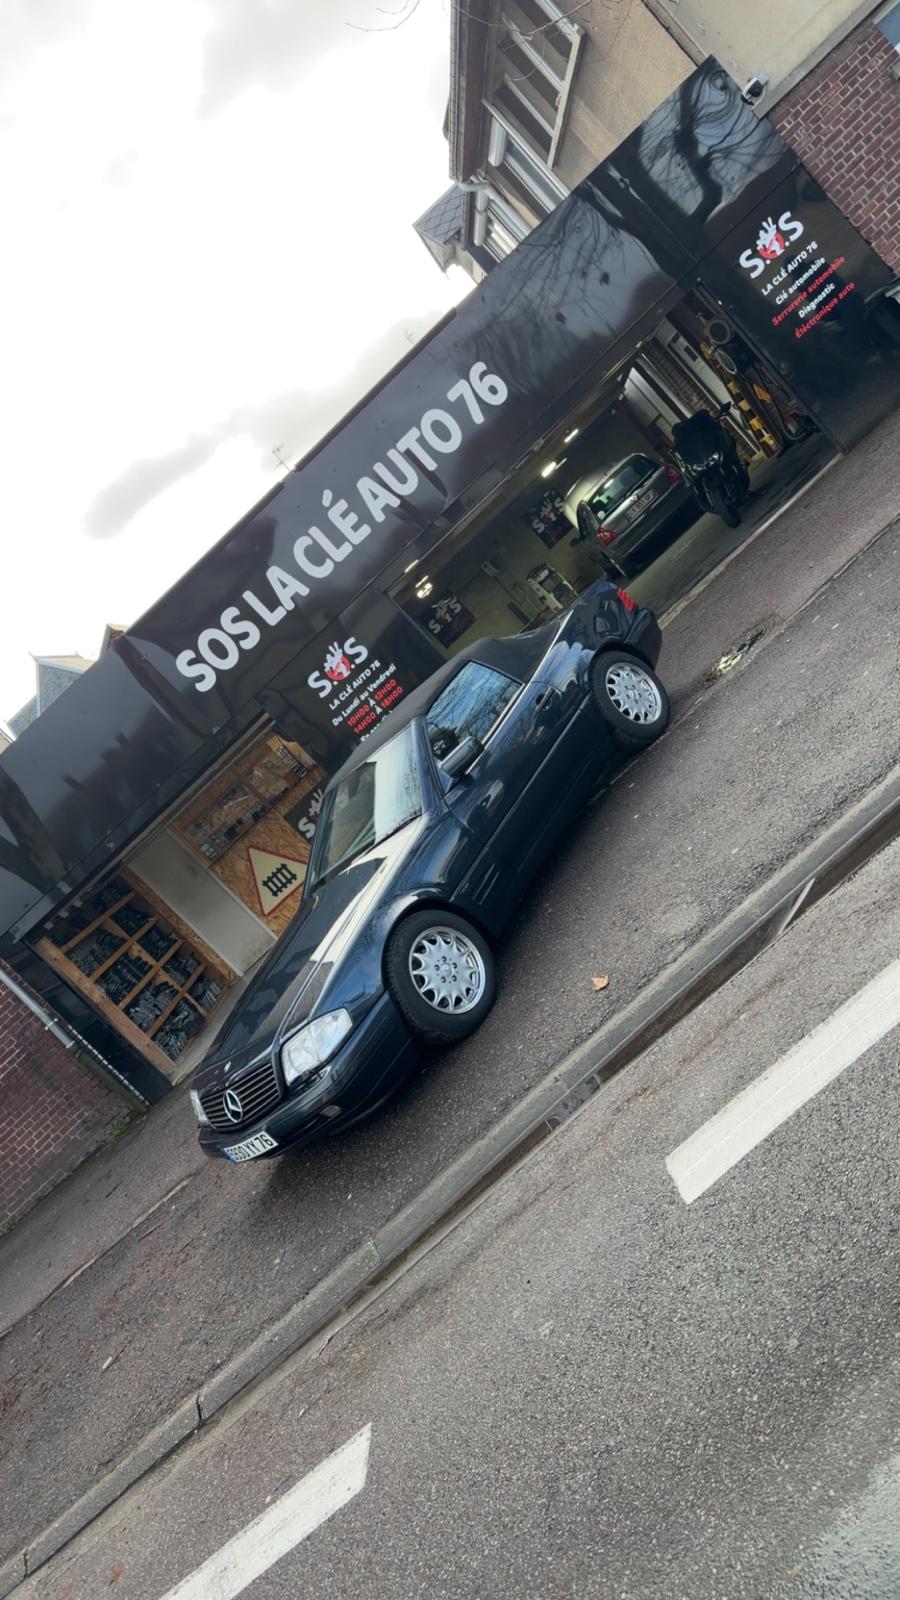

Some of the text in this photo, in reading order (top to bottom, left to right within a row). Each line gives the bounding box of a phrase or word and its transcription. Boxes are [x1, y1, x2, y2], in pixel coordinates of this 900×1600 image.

[761, 240, 818, 296] LA CLÉ AUTO 76
[771, 256, 845, 326] Serrurerie automobile
[775, 257, 826, 305] Clé automobile
[838, 282, 855, 300] auto
[798, 282, 835, 318] Diagnostic
[175, 361, 508, 692] SOS LA CLÉ AUTO 76
[329, 660, 381, 710] LA CLÉ AUTO 76
[332, 715, 344, 726] Du
[341, 698, 360, 717] Lundi
[359, 690, 369, 701] au
[367, 663, 397, 692] Vendredi
[347, 704, 370, 727] 10H00
[375, 679, 397, 701] 12H00
[354, 712, 377, 734] 14H00
[381, 686, 404, 709] 18H00
[254, 1134, 274, 1150] 76
